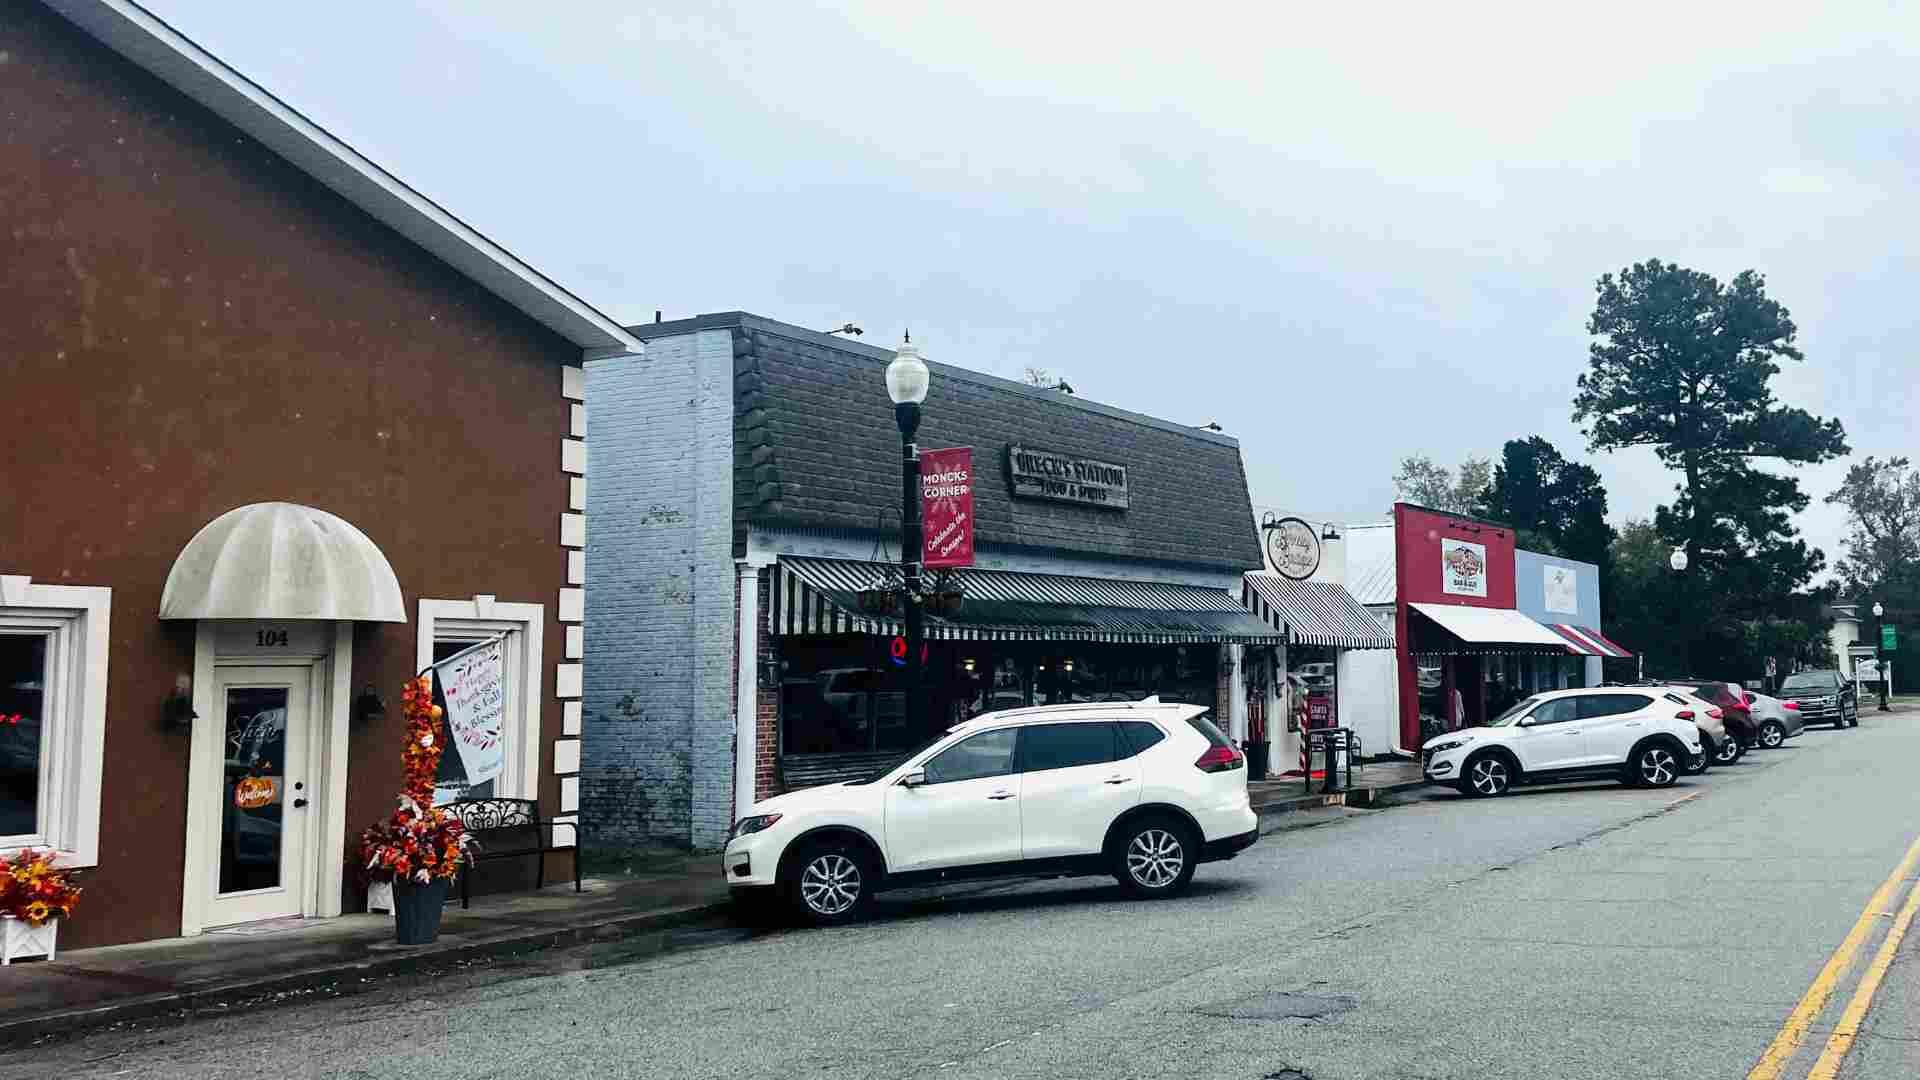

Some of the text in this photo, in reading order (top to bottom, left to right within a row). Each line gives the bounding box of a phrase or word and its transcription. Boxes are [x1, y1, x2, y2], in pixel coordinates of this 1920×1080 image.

[922, 471, 968, 486] MONCKS
[1074, 461, 1123, 487] STATION
[924, 485, 969, 498] CORNER
[928, 522, 956, 551] Celebrate
[255, 630, 289, 647] 104
